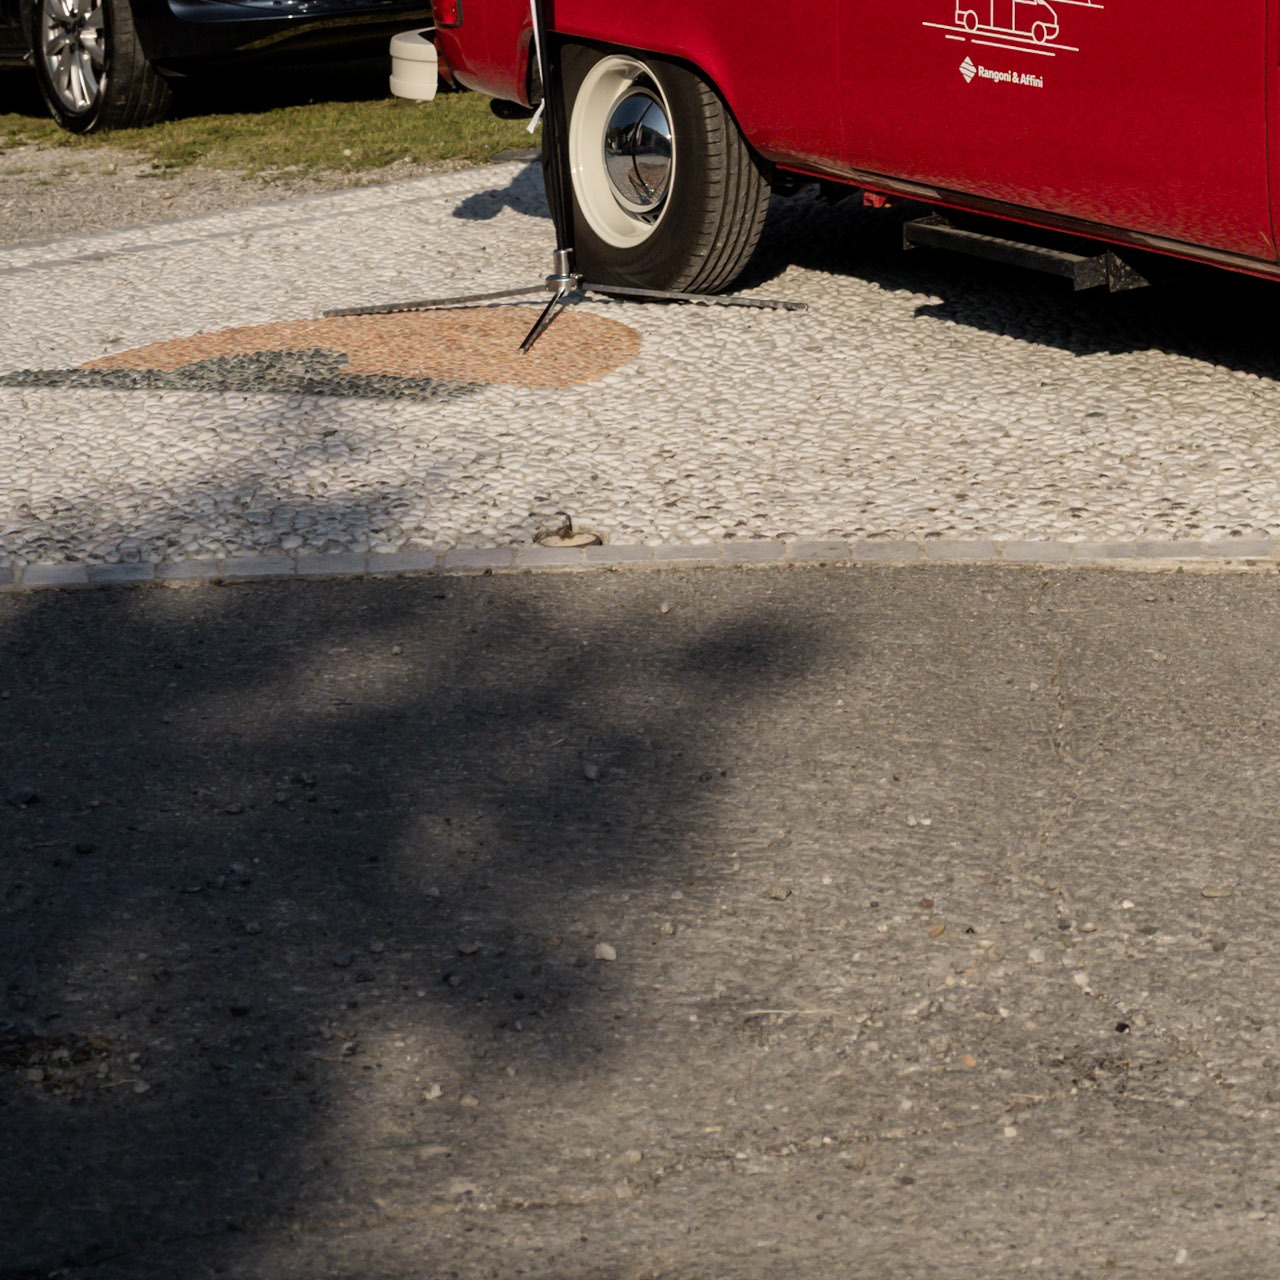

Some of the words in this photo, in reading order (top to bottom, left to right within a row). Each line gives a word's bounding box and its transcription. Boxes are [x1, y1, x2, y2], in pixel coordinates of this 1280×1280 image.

[977, 65, 1012, 83] Rangoni
[1012, 71, 1019, 84] &
[1020, 73, 1043, 88] Affini
